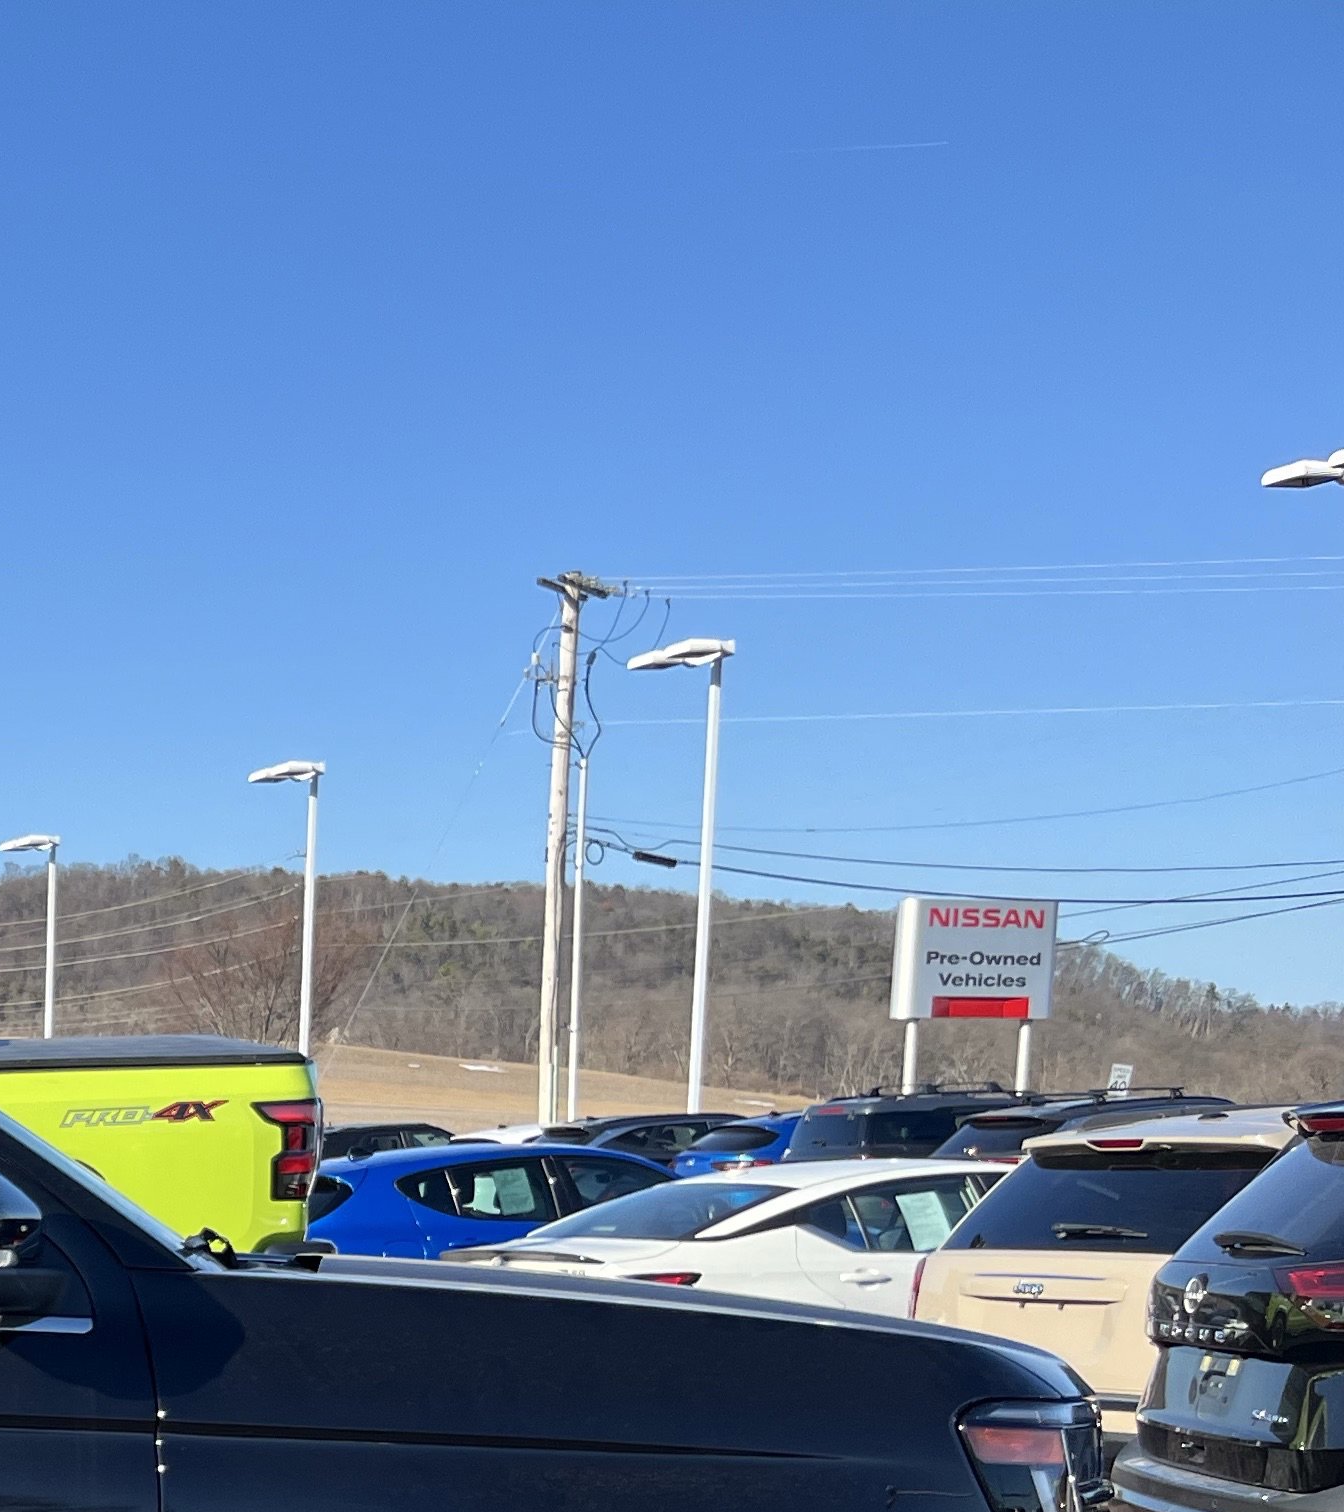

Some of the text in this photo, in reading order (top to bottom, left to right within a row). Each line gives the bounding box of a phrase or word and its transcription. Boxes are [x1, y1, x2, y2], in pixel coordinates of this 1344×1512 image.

[928, 906, 1046, 929] NISSAN
[926, 950, 1042, 966] Pre-Owned
[938, 972, 1027, 988] Vehicles
[1013, 1280, 1044, 1298] Jeep
